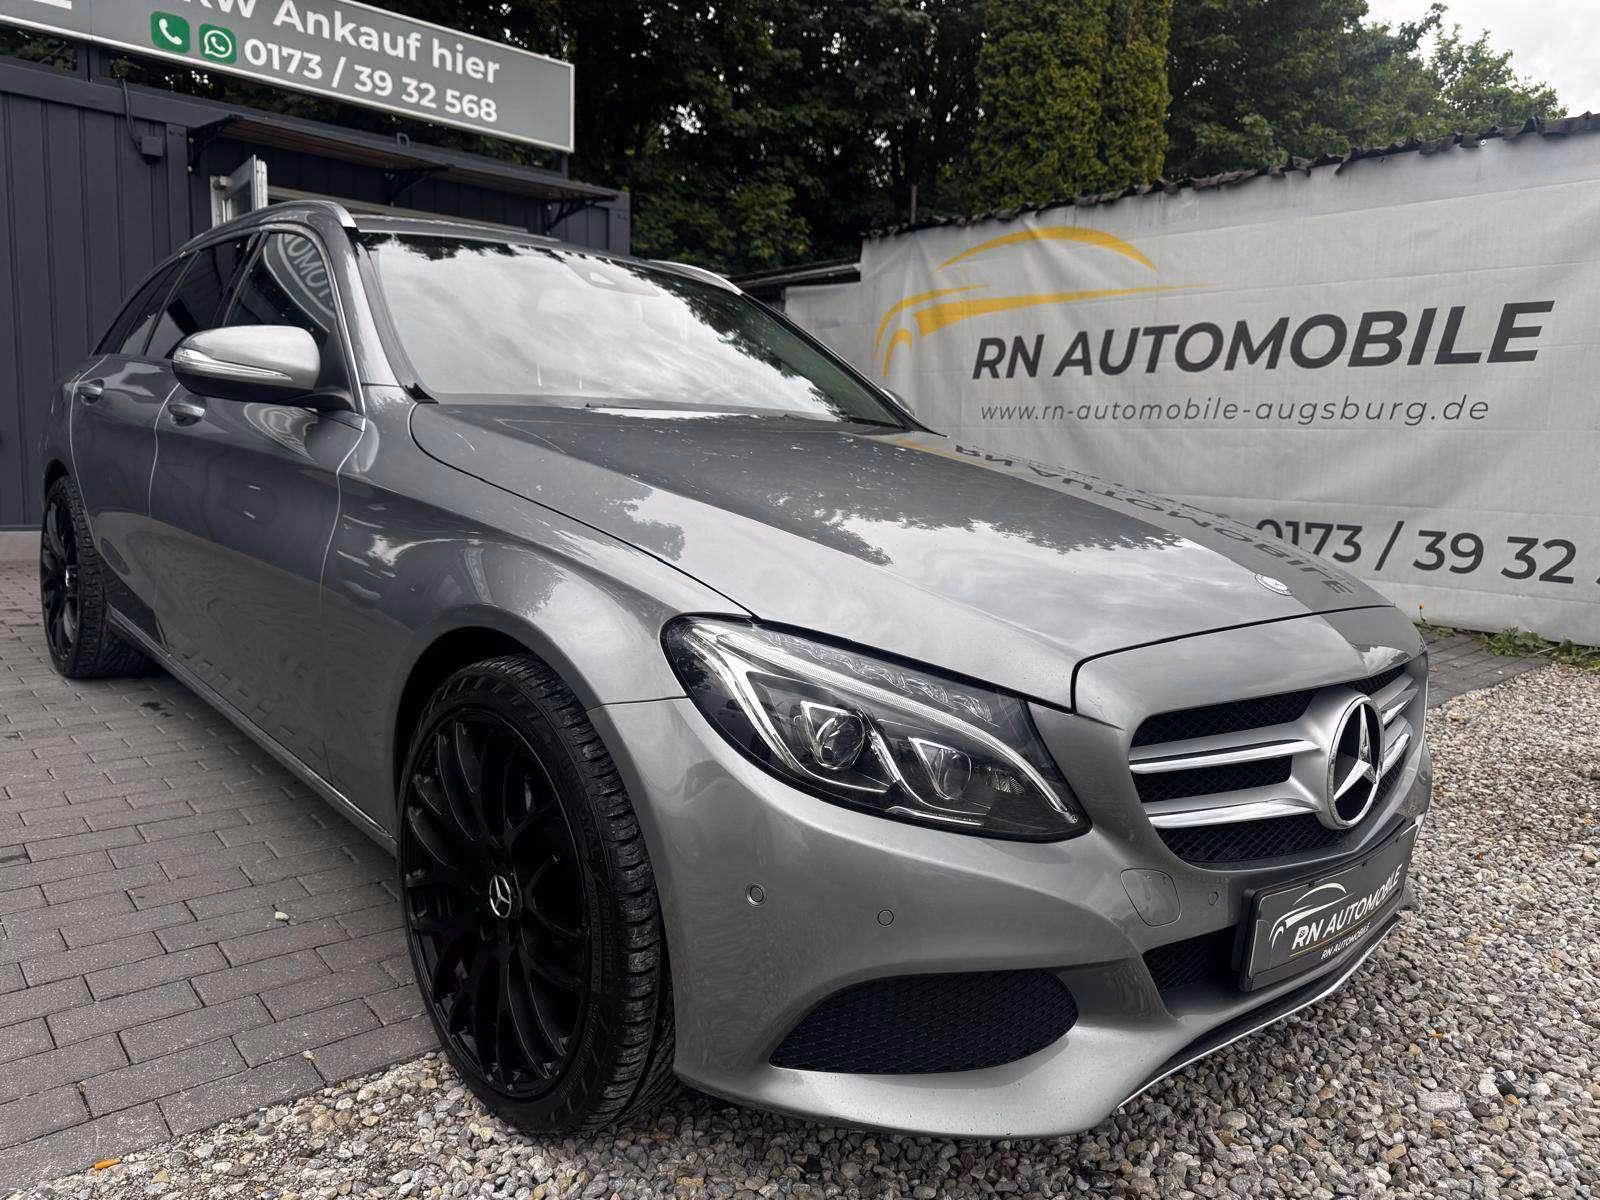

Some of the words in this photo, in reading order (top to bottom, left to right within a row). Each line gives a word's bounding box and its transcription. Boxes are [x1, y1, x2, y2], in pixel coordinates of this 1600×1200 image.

[243, 38, 323, 80] 0173
[331, 56, 347, 89] /
[353, 64, 394, 97] 39
[401, 75, 438, 109] 32
[444, 88, 498, 123] 568
[272, 0, 422, 62] Ankauf
[432, 37, 500, 84] hier
[972, 333, 1046, 380] RN
[1051, 299, 1556, 378] AUTOMOBILE
[980, 393, 1490, 427] www.rn-automobile-augsburg.de
[1373, 519, 1406, 572] /
[1412, 529, 1485, 575] 39
[1500, 535, 1577, 585] 32
[1291, 918, 1325, 951] RN
[1321, 863, 1403, 938] AUTOMOBILE
